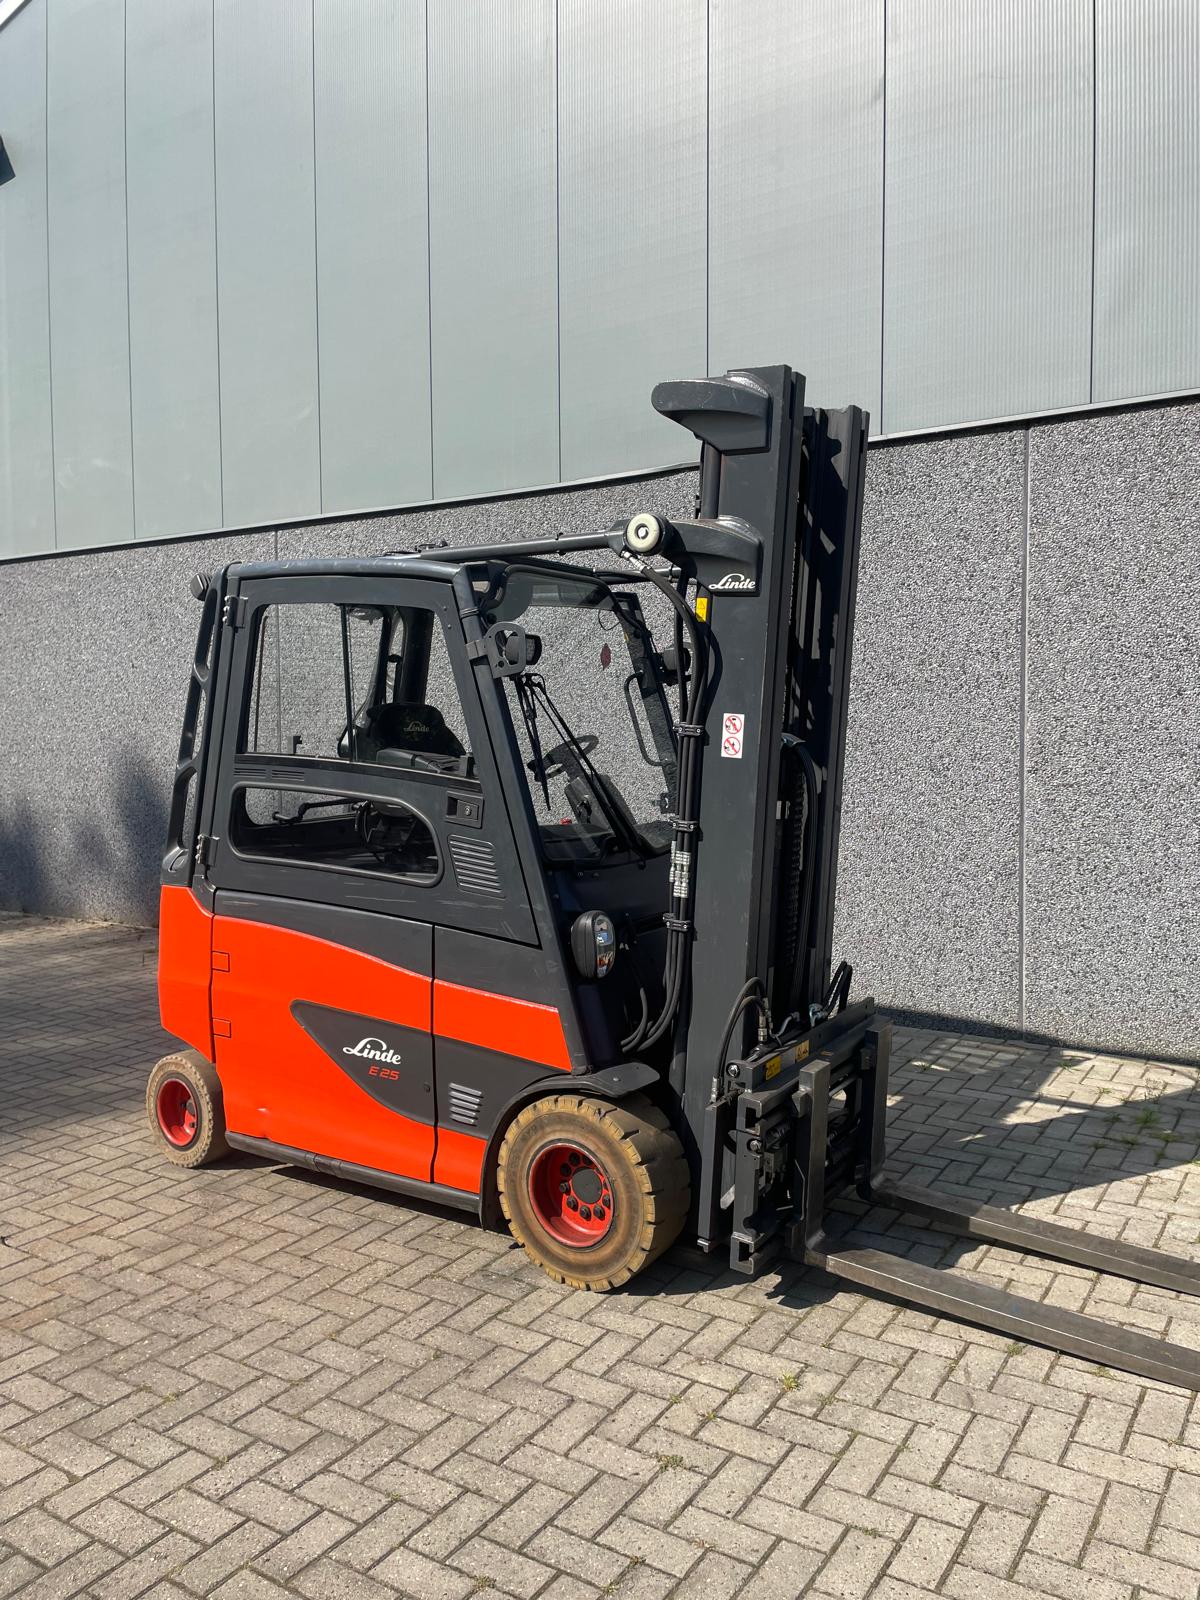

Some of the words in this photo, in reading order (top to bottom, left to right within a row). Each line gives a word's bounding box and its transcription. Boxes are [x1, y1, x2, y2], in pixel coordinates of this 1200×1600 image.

[709, 573, 756, 590] Linde
[403, 720, 430, 732] Linde
[342, 1037, 402, 1065] Linde
